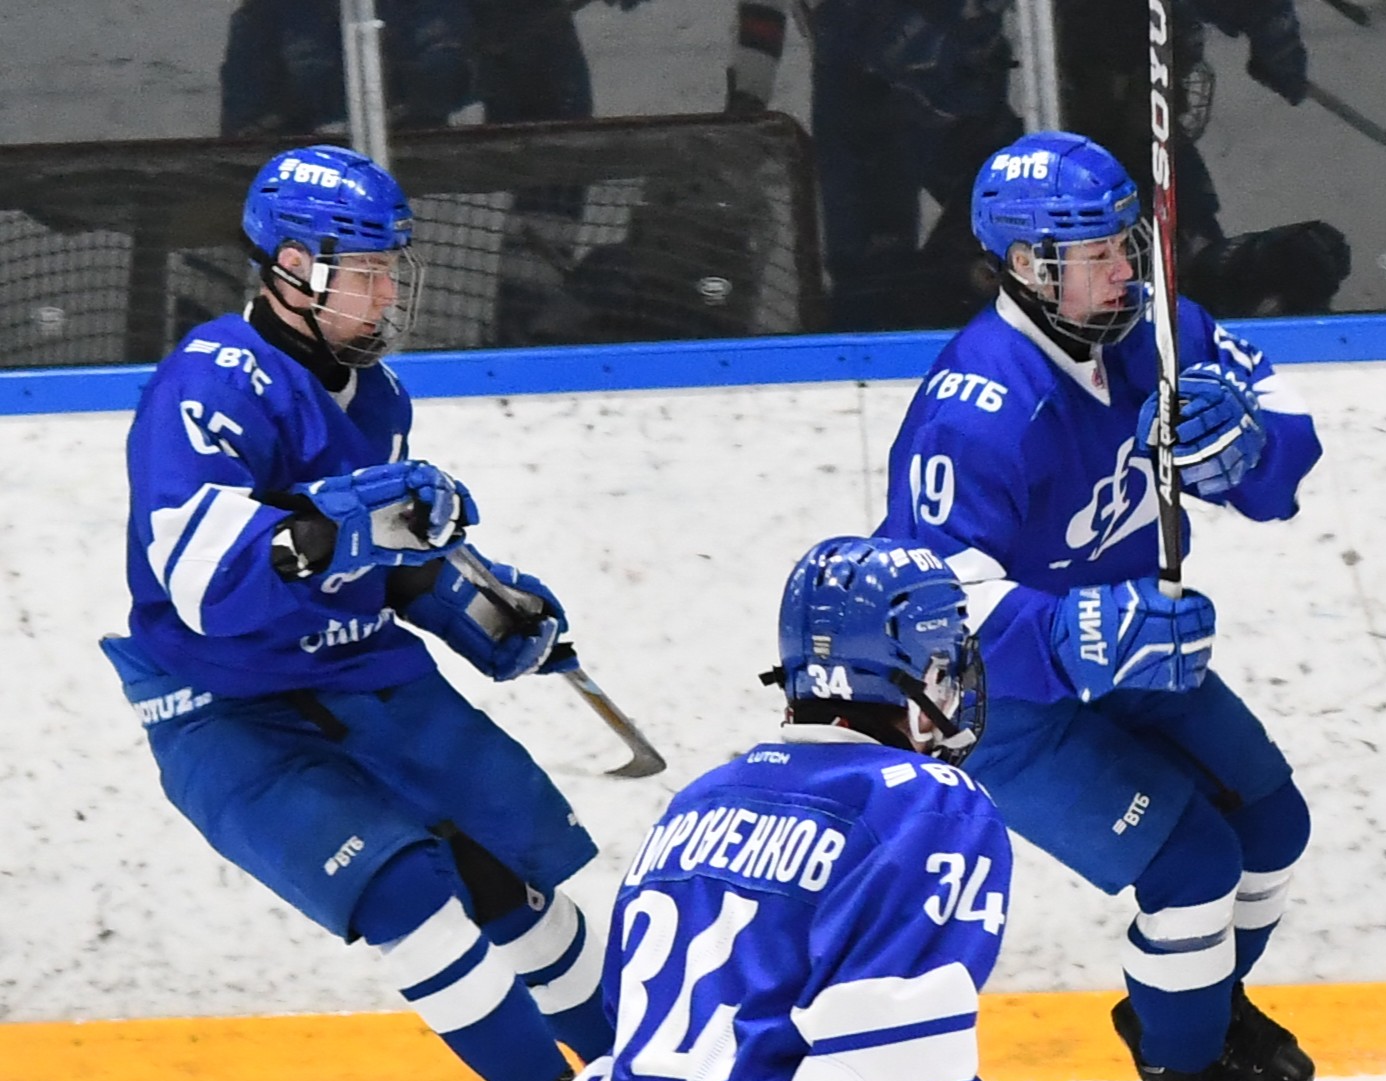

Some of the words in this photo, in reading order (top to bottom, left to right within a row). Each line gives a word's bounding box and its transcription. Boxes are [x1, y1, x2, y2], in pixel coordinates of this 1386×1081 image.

[1006, 153, 1049, 182] ВТБ
[936, 371, 1009, 413] ВТБ
[807, 664, 854, 701] 34
[132, 686, 195, 725] OYUZ
[1123, 792, 1150, 827] ВТБ
[923, 852, 1005, 936] 34
